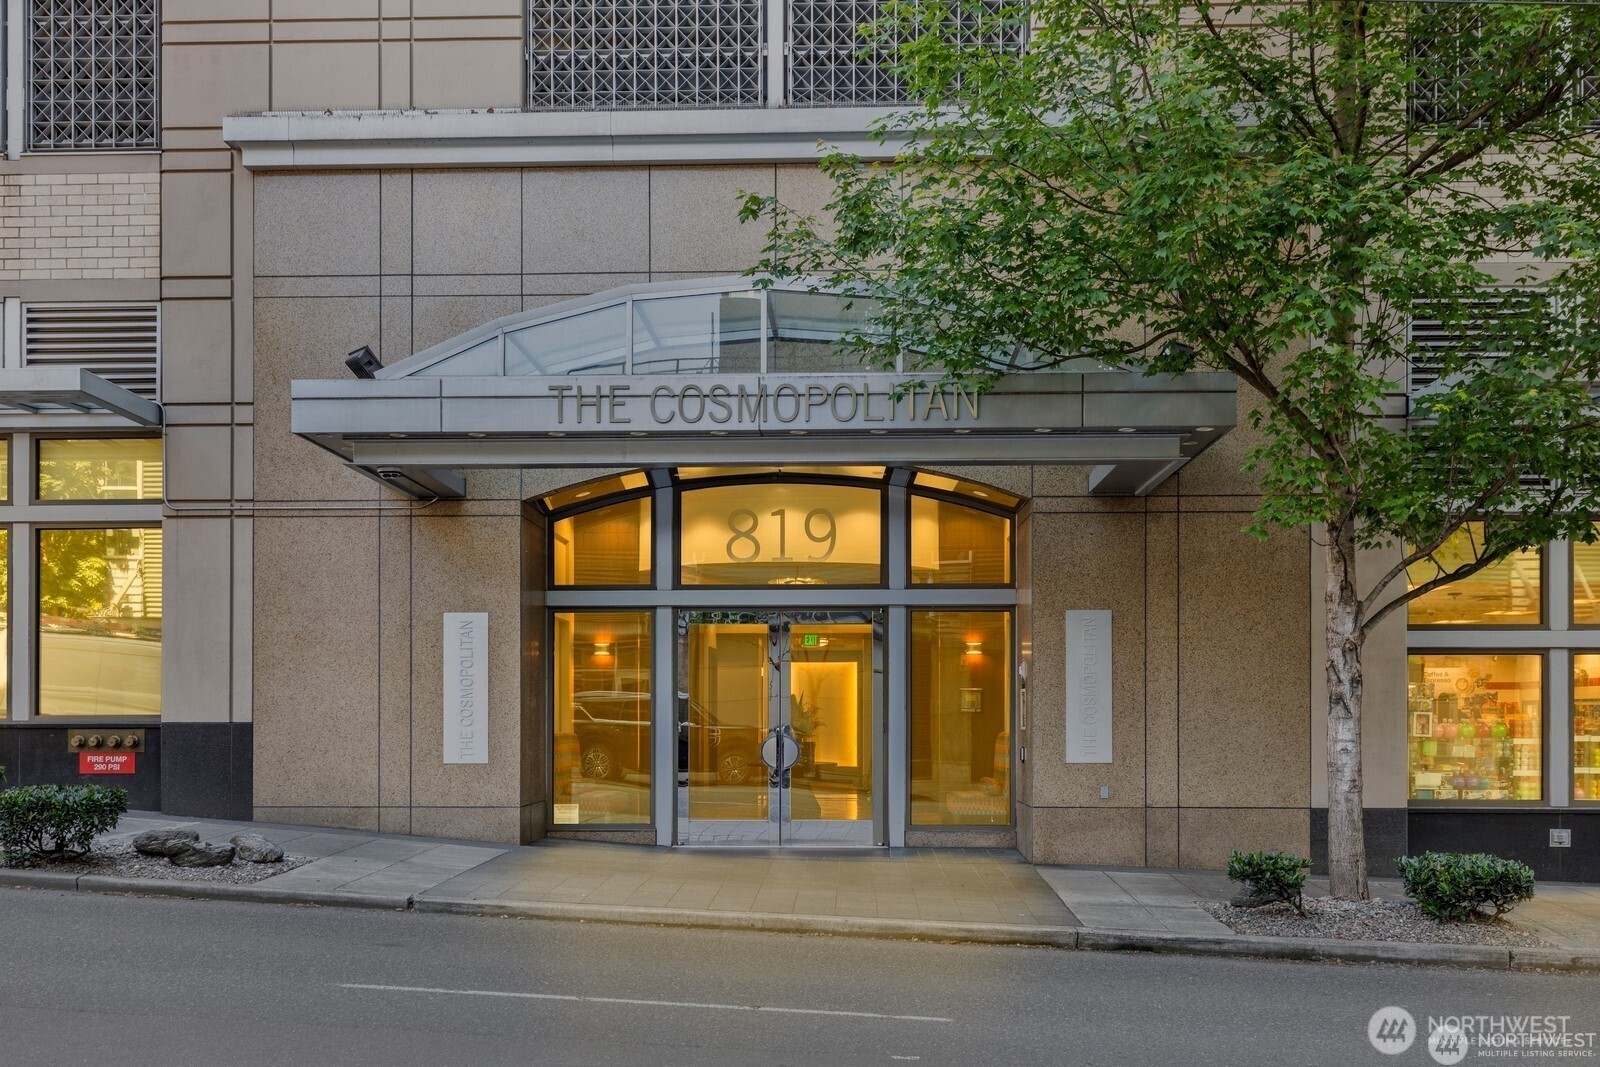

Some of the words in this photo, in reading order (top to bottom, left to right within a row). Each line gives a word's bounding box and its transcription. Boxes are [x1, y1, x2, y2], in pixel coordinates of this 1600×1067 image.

[548, 384, 631, 424] THE
[650, 382, 979, 424] COSMOPOLITAN
[726, 508, 837, 563] 819
[804, 634, 818, 646] EXIT
[460, 620, 474, 727] COSMOPOLITAN
[1081, 616, 1097, 725] COSMOPOLITAN
[460, 730, 474, 759] THE
[1082, 729, 1097, 758] THE
[87, 755, 104, 763] FIRE
[105, 755, 128, 763] PUMP
[108, 763, 120, 771] PSI
